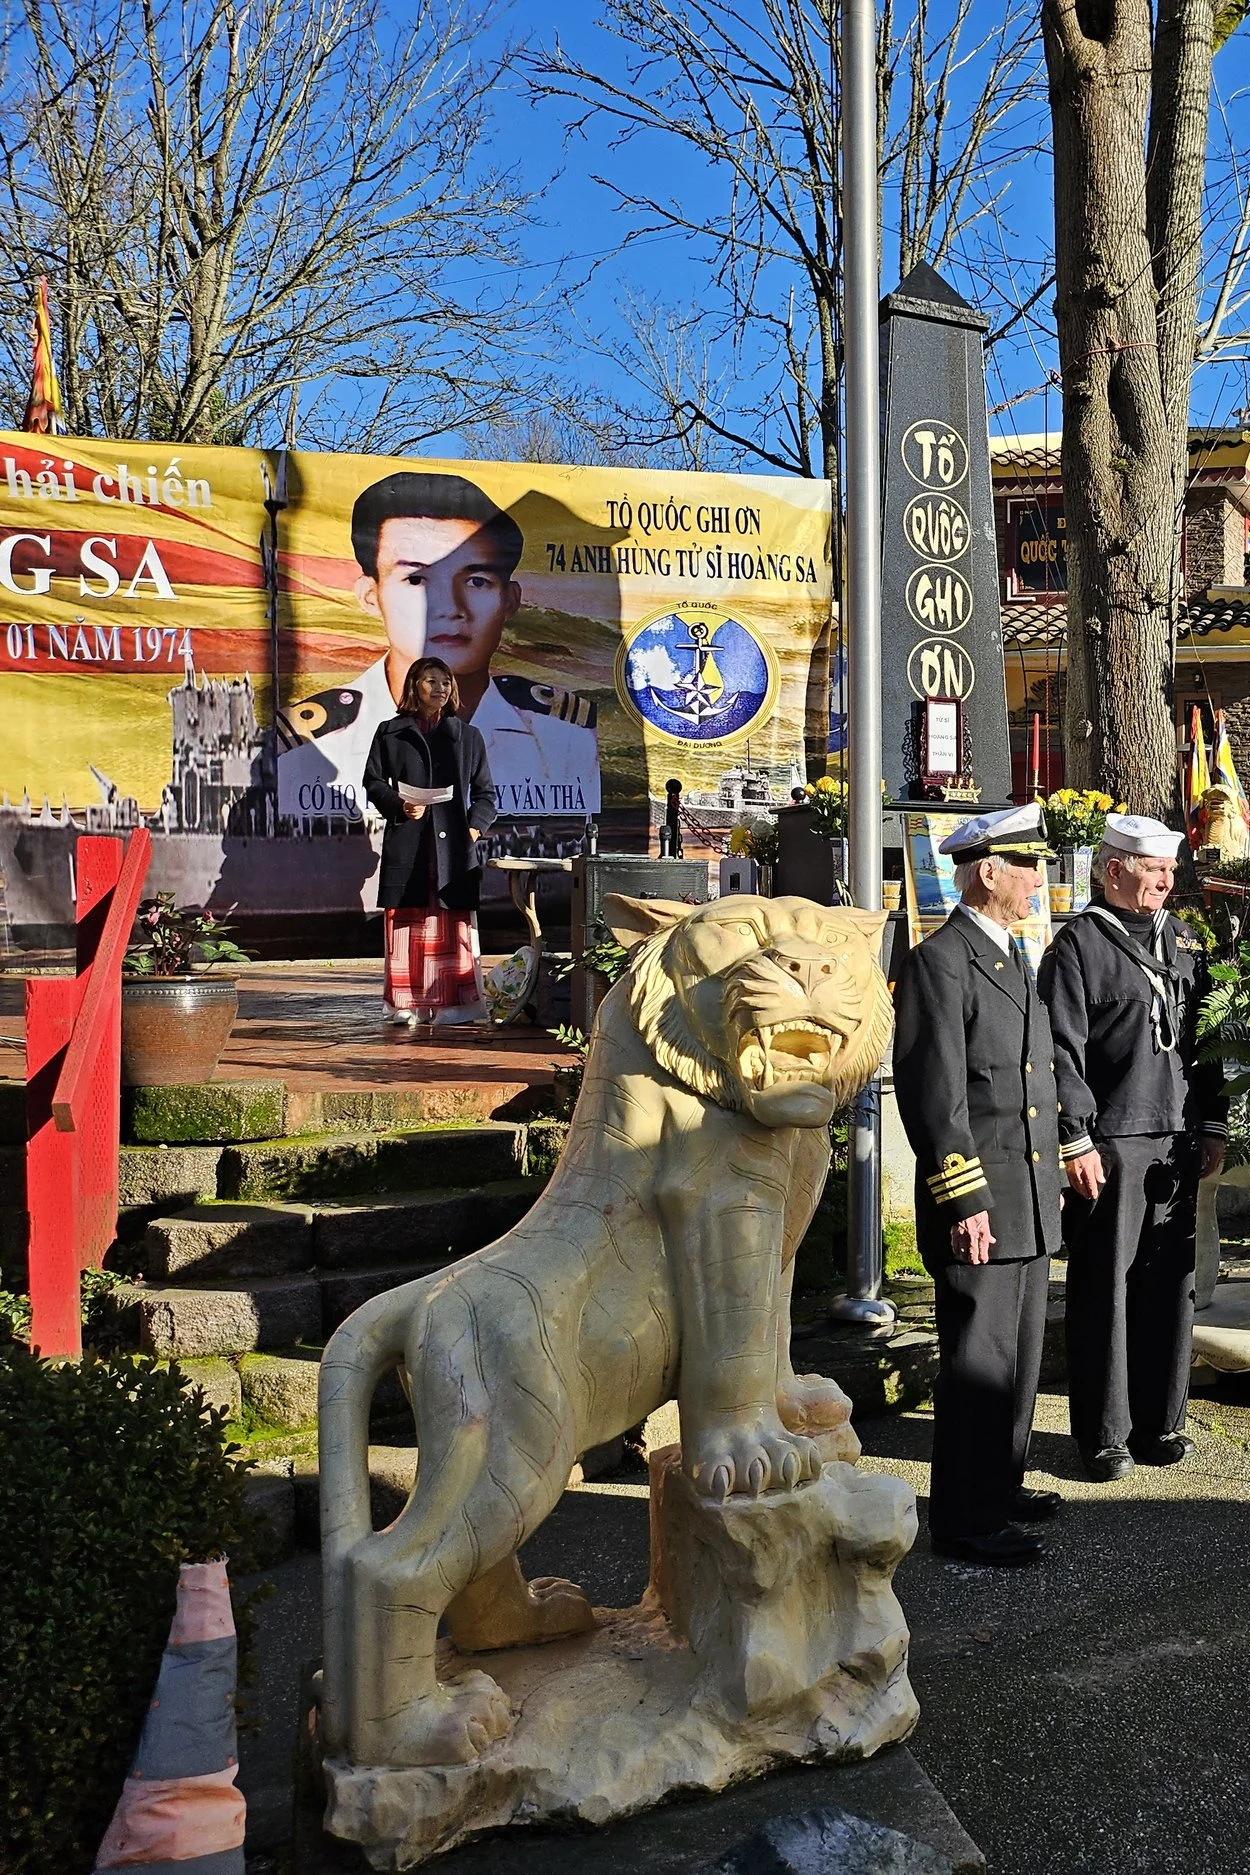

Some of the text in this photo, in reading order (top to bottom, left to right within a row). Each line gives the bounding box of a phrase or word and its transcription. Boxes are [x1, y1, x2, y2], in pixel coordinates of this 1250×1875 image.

[3, 457, 214, 508] hải chiến
[637, 496, 692, 537] QUỐC
[696, 506, 731, 534] GHI
[735, 506, 761, 535] ƠN
[912, 502, 964, 555] QUỐC
[79, 537, 180, 601] SA
[546, 543, 567, 573] 74
[570, 544, 613, 574] ANH
[616, 539, 672, 577] HÙNG
[675, 542, 703, 578] TỬ
[727, 545, 791, 582] HOÀNG
[795, 556, 818, 584] SA
[915, 574, 963, 628] GHI
[6, 615, 194, 663] 01 NĂM 1974
[298, 776, 325, 811] CỐ
[330, 784, 359, 817] HQ
[510, 777, 546, 810] VĂN
[550, 776, 587, 810] THÀ
